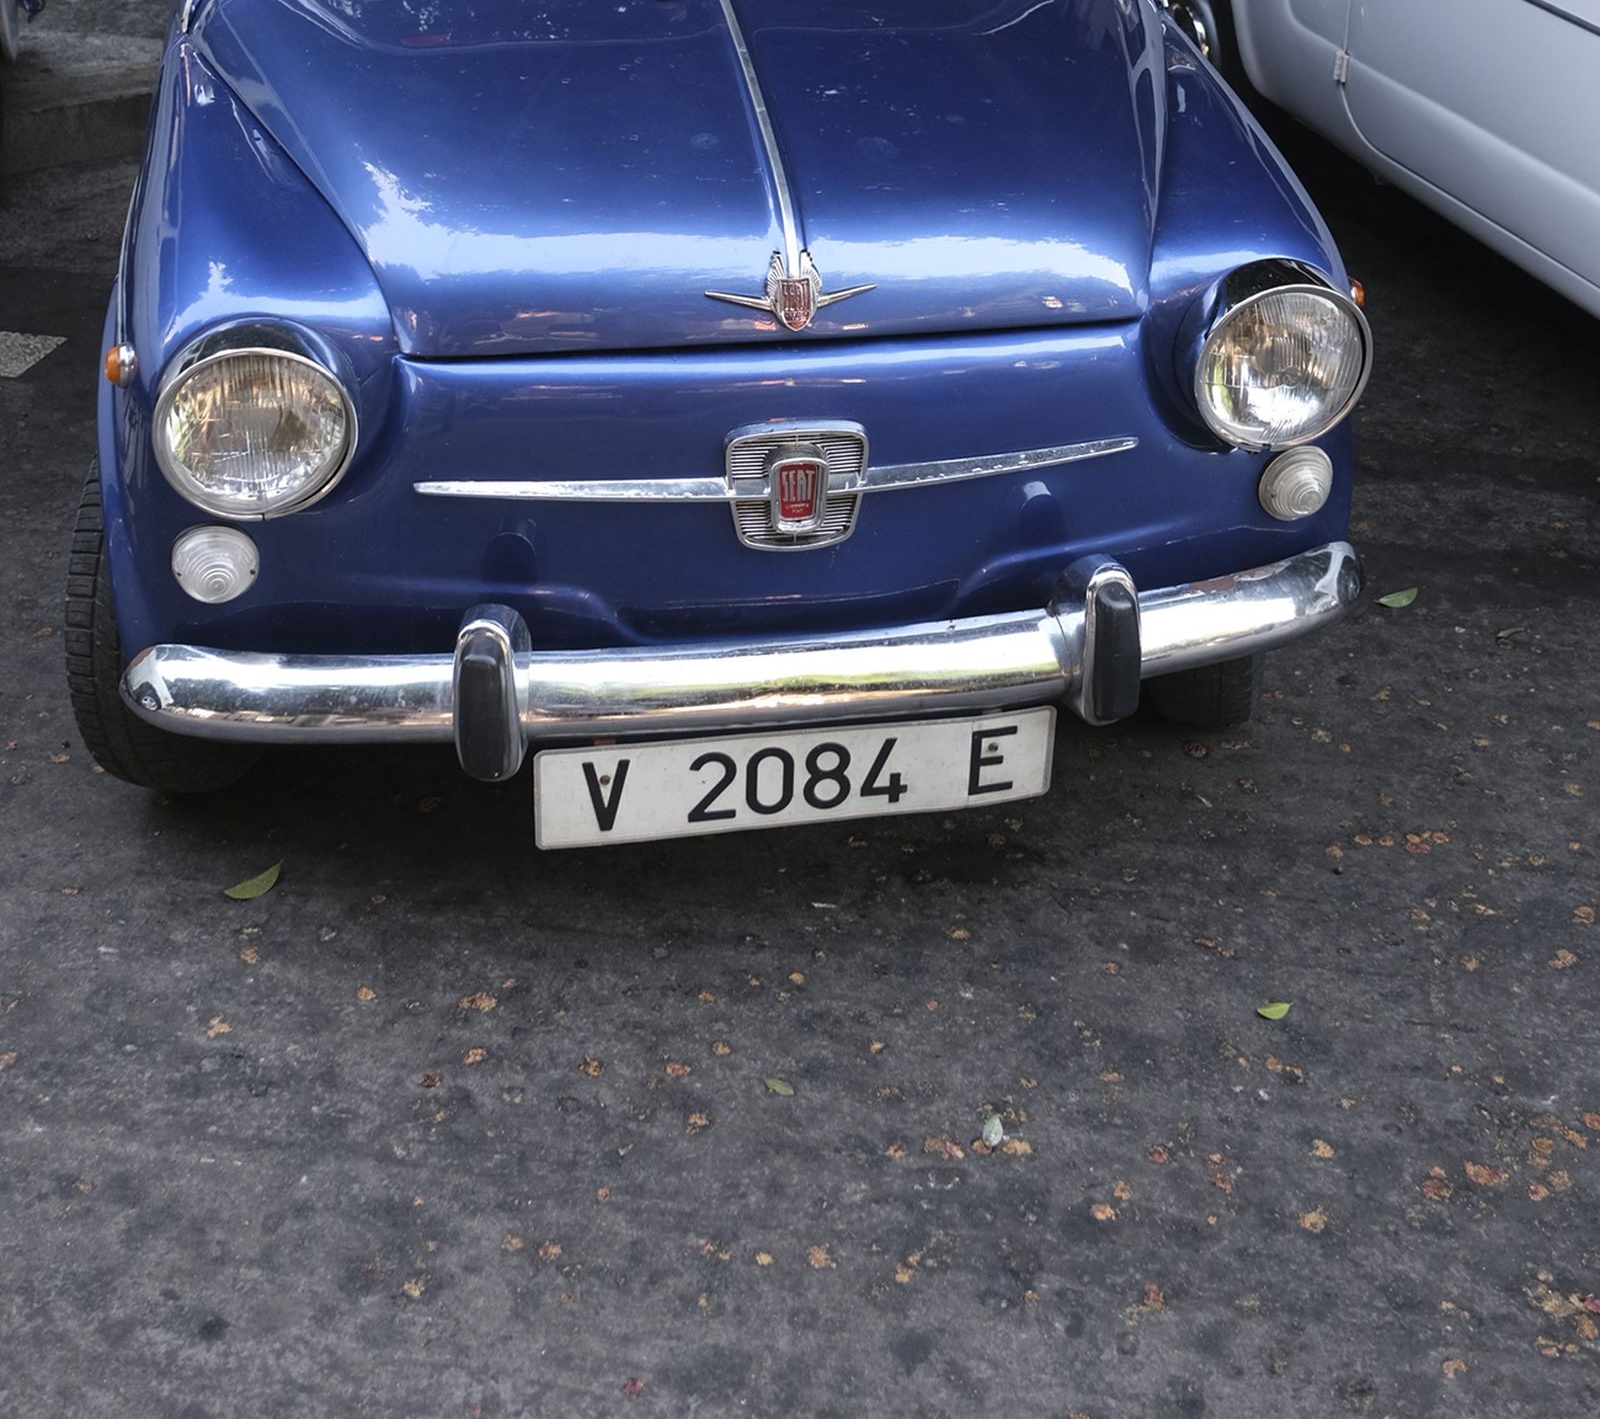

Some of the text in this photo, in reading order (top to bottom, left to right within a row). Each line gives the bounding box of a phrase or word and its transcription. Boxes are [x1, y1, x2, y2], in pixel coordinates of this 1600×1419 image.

[782, 469, 815, 502] SEAT
[582, 726, 1018, 831] V 2084 E
